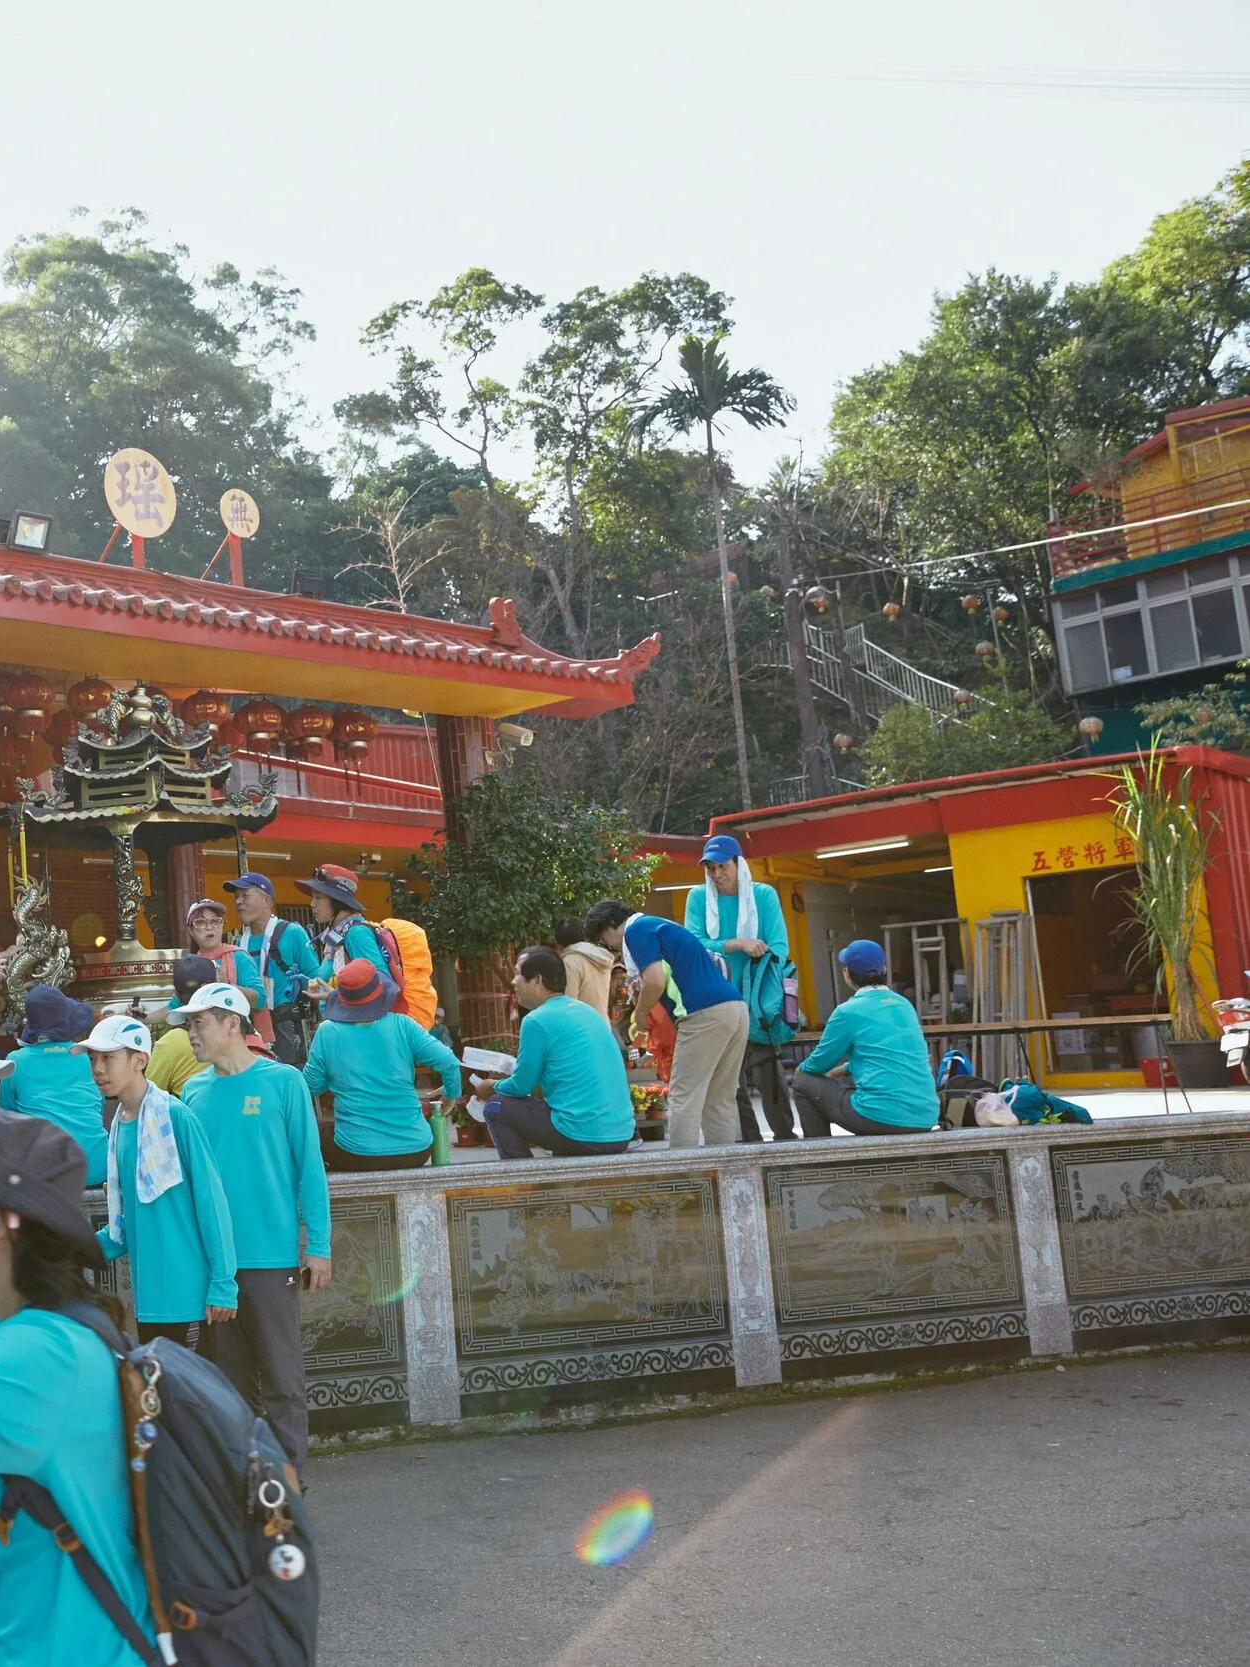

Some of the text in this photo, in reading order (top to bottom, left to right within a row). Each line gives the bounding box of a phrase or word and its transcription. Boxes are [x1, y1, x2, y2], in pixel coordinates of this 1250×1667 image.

[228, 494, 253, 533] 無
[1031, 836, 1137, 872] 五營將軍
